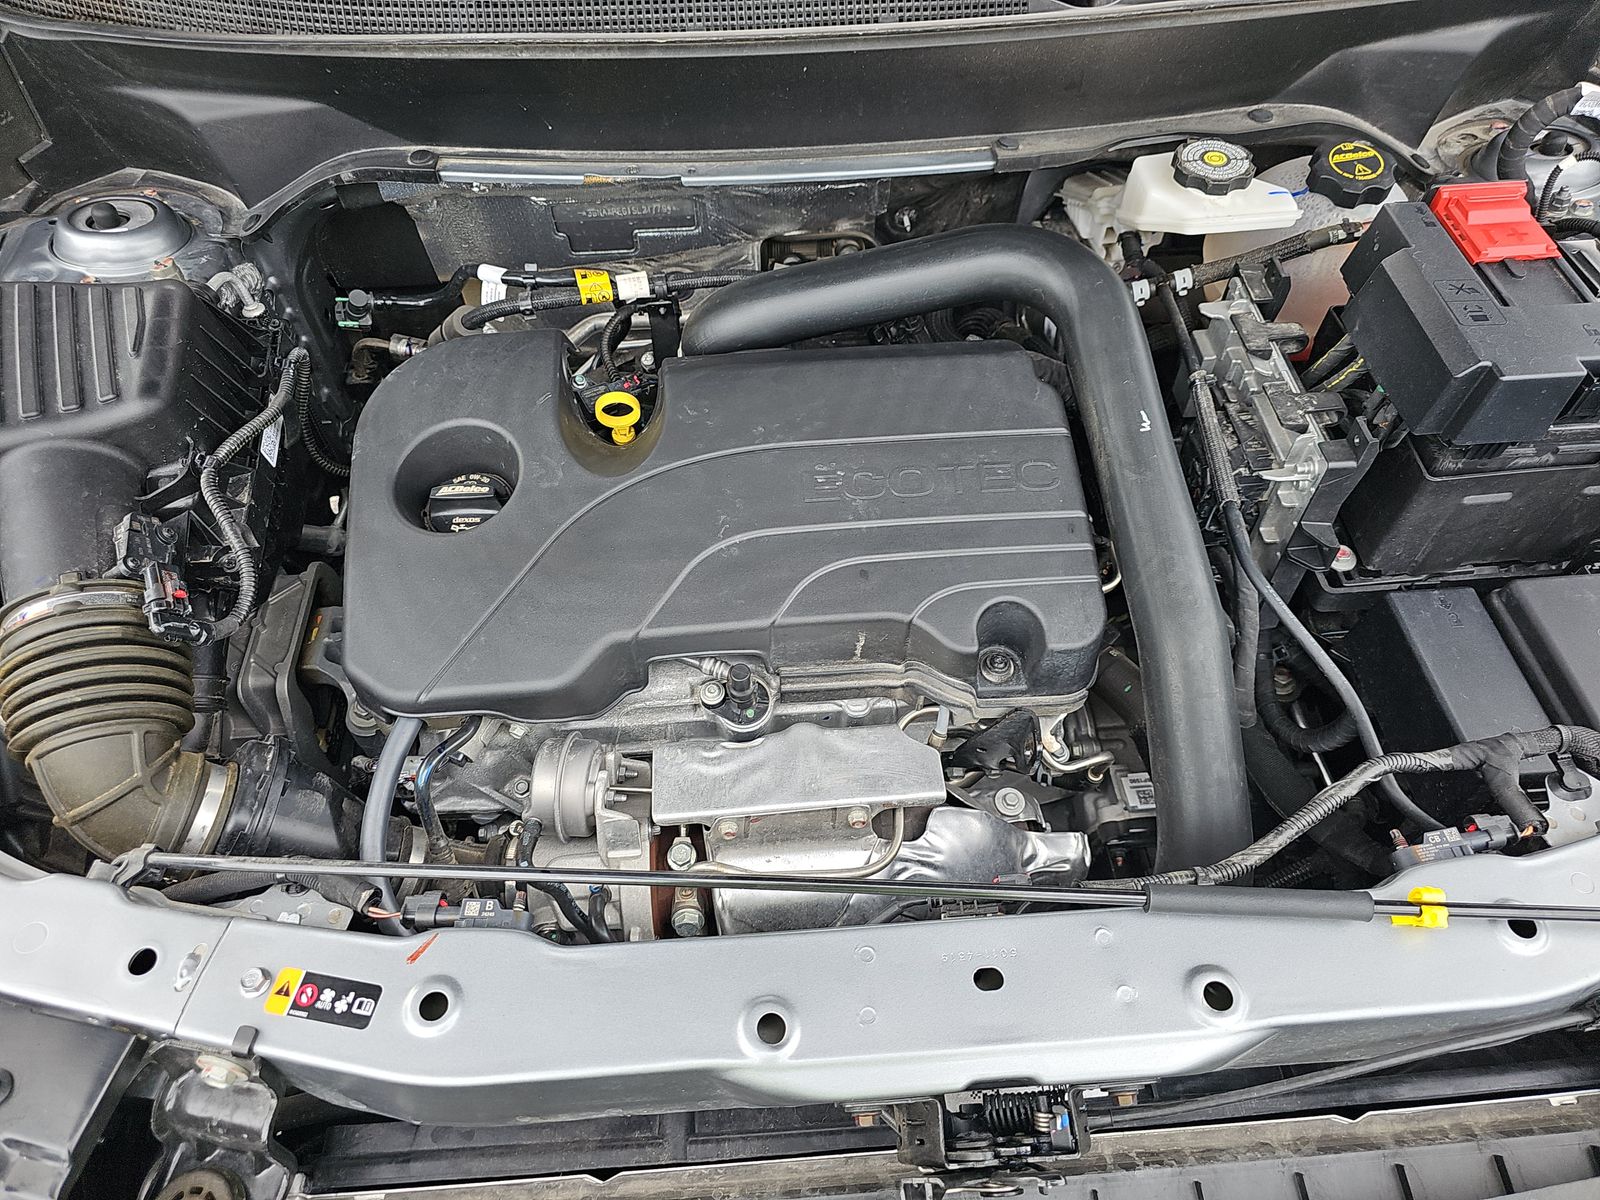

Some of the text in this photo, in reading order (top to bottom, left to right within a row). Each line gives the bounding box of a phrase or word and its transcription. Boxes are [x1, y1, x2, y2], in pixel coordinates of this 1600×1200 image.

[452, 474, 491, 484] SAE 0W-20
[805, 460, 1061, 502] ECOTEC
[435, 485, 490, 496] ACDelco
[452, 516, 482, 524] dexos
[1428, 834, 1441, 844] CB
[485, 900, 495, 911] B
[314, 1000, 333, 1011] AUTO
